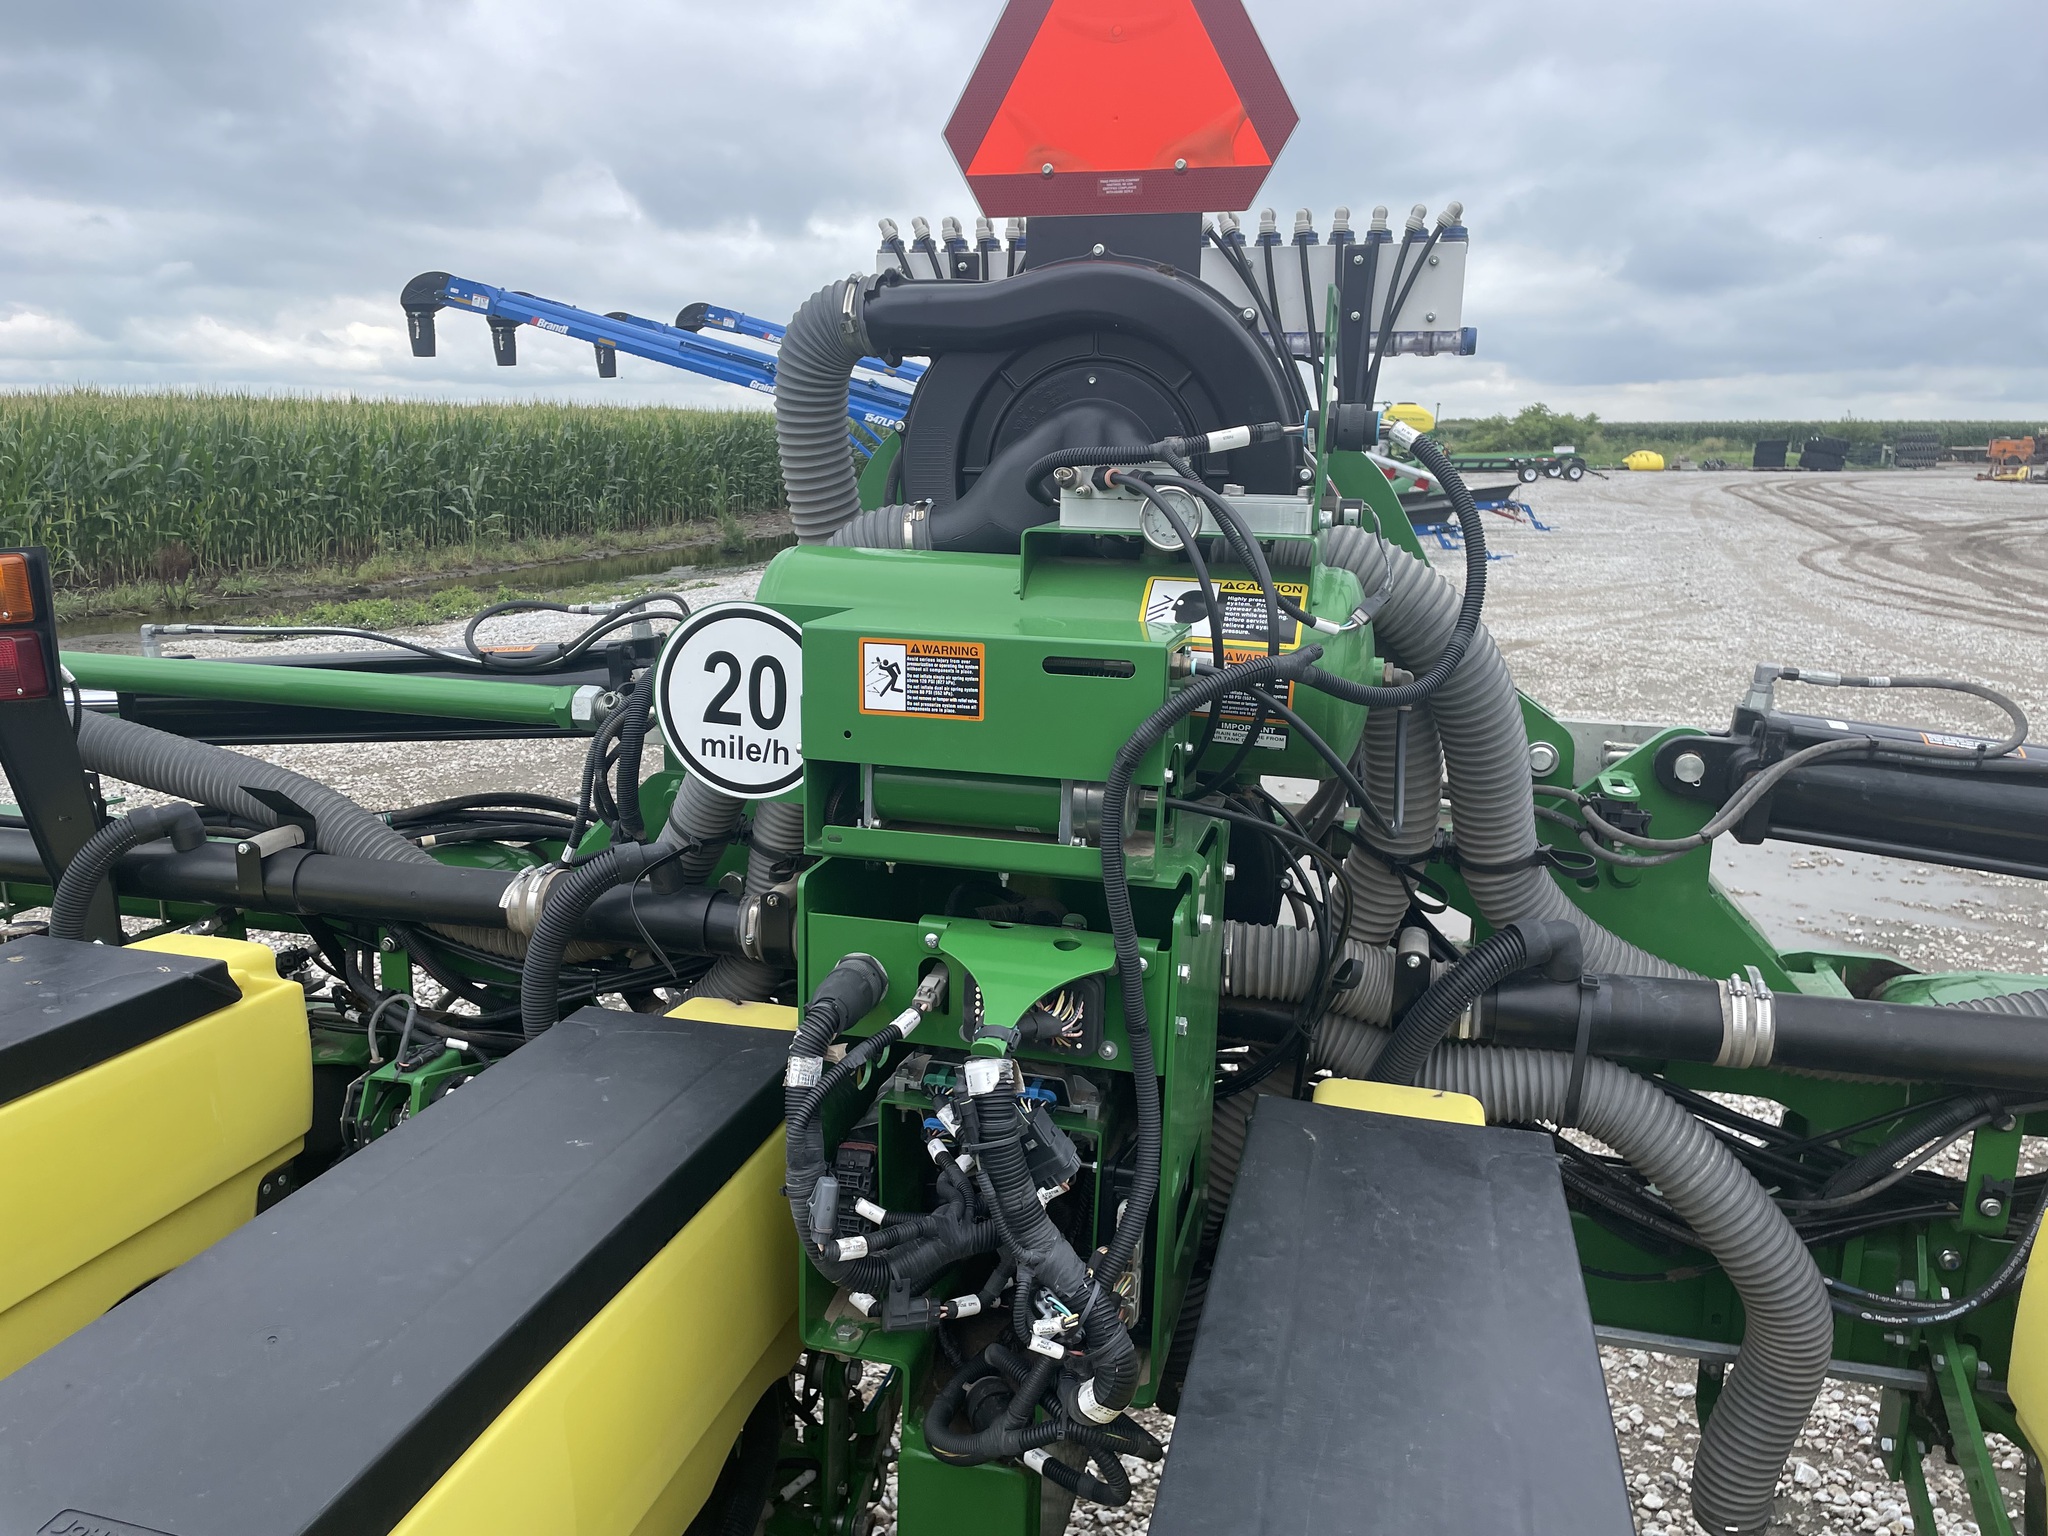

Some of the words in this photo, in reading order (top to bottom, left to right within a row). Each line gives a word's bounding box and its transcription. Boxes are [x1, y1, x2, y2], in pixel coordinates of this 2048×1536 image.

[537, 318, 569, 335] Brandt
[865, 413, 895, 427] 1547LP
[922, 644, 978, 656] WARNING
[702, 650, 787, 731] 20
[701, 735, 789, 765] mile/h
